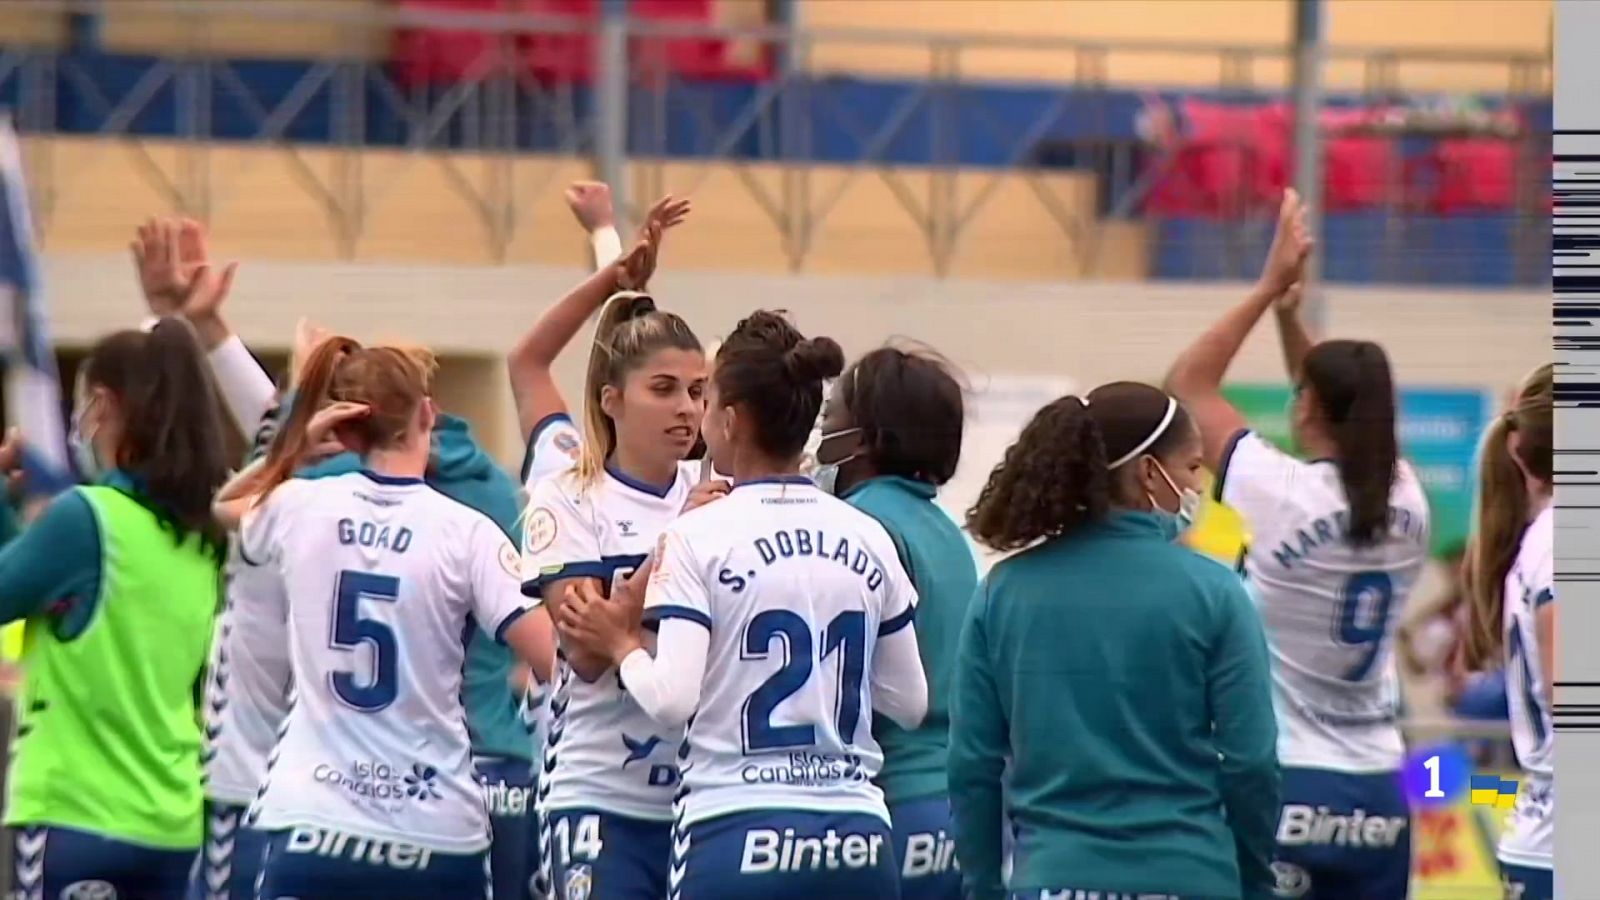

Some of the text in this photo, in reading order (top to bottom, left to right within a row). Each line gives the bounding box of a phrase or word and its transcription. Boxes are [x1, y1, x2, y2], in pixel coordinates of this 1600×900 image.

[338, 517, 413, 554] GOAD
[718, 528, 883, 593] S. DOBLADO
[327, 569, 400, 713] 5
[1329, 569, 1392, 683] 9
[739, 608, 866, 756] 21
[480, 774, 534, 817] inter
[741, 764, 841, 784] Canarias
[554, 814, 602, 864] 14
[1275, 804, 1408, 847] Binter
[740, 827, 883, 875] Binter
